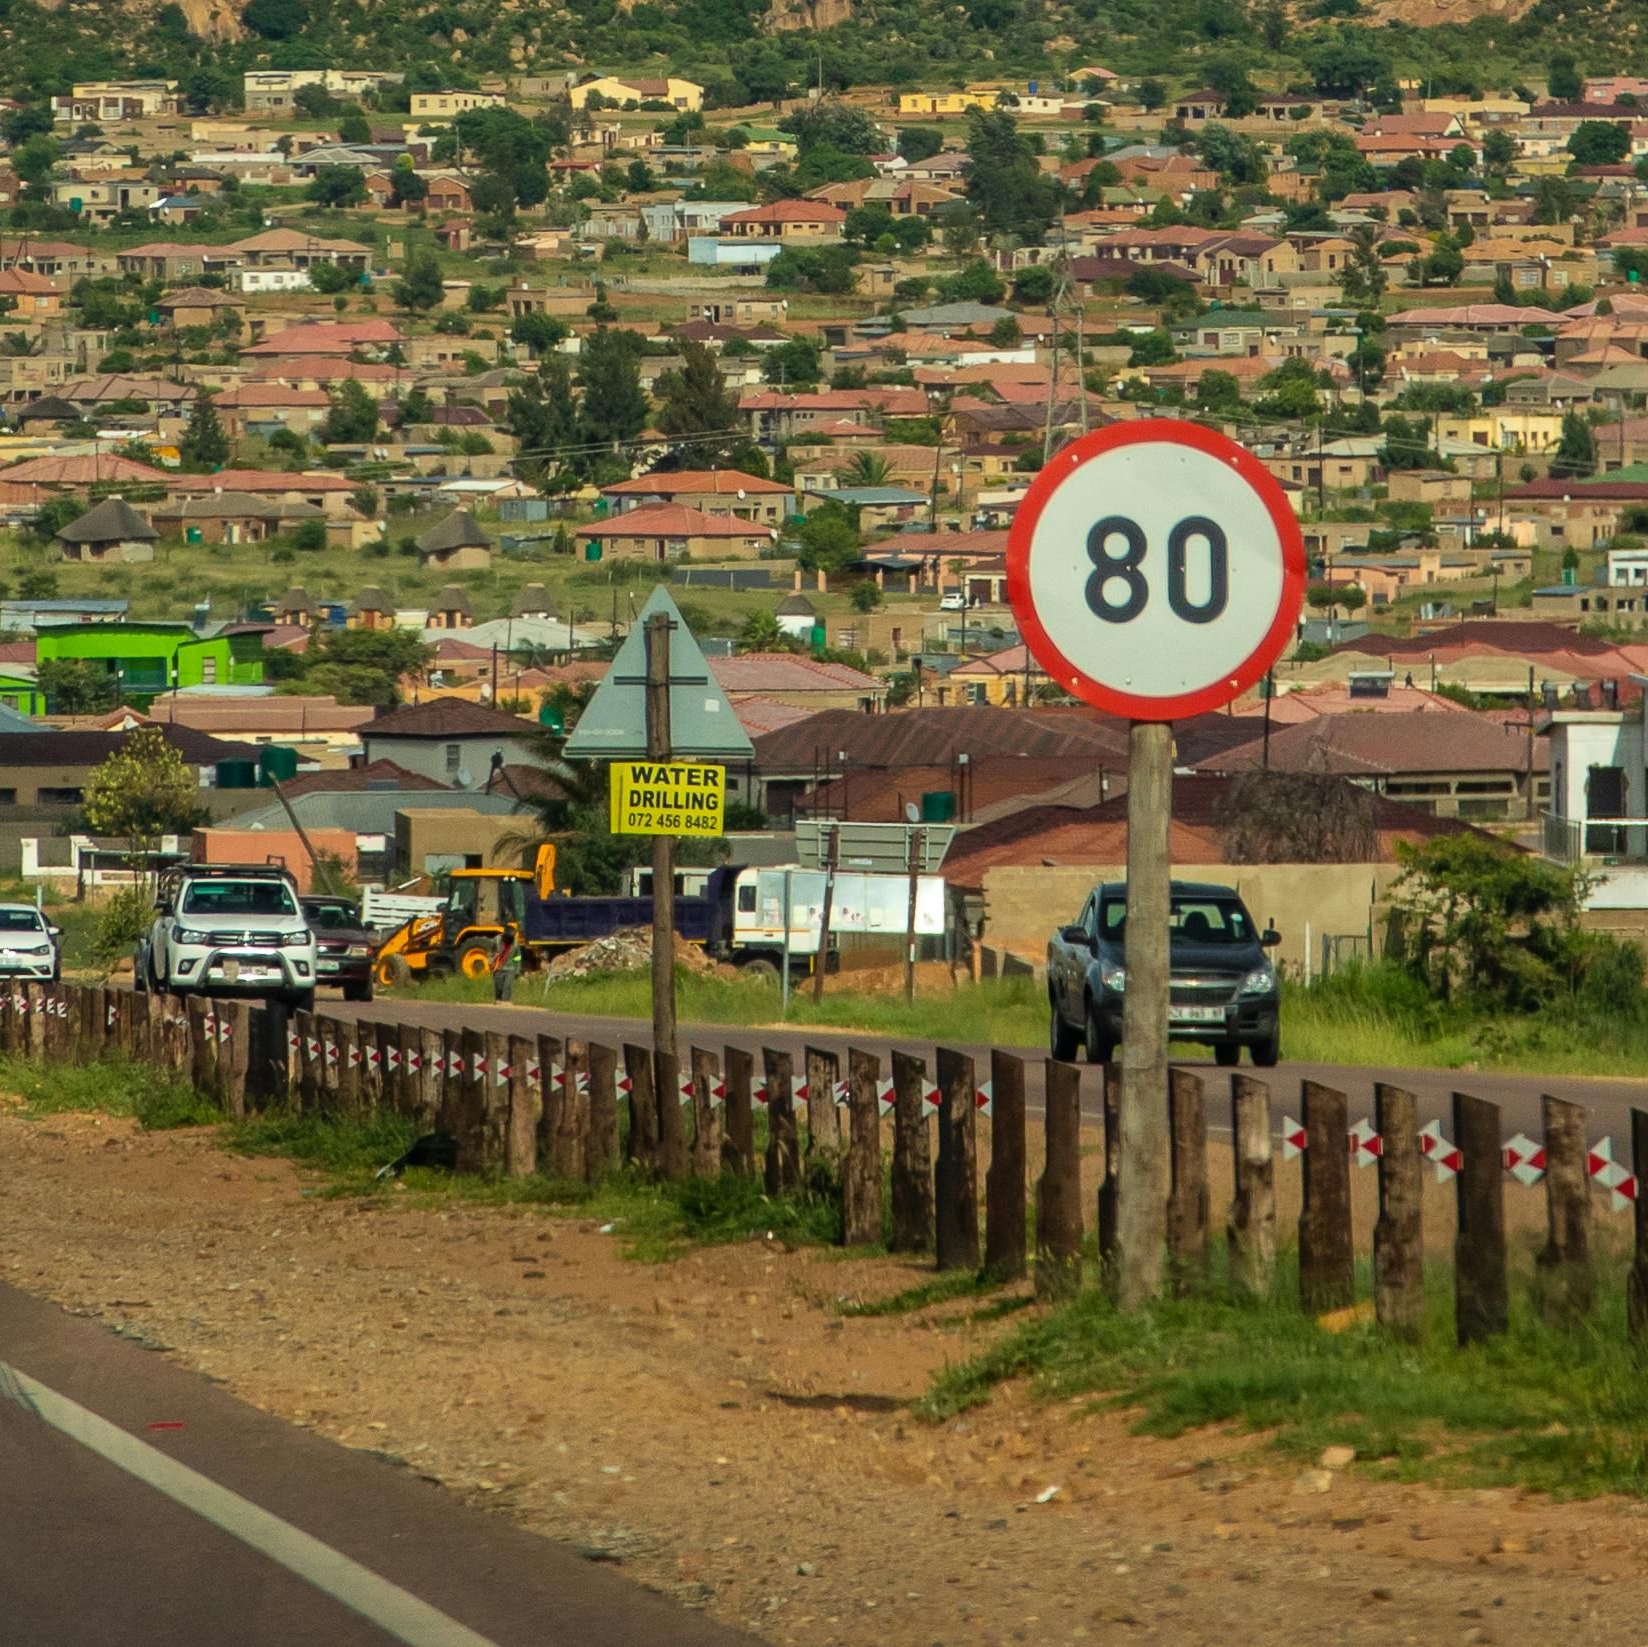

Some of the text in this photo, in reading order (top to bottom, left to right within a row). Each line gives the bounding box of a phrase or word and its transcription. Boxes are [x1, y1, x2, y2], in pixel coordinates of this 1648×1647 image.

[1084, 514, 1229, 624] 80
[631, 766, 719, 786] WATER
[629, 789, 718, 810] DRILLING
[628, 813, 718, 830] 072 456 8482
